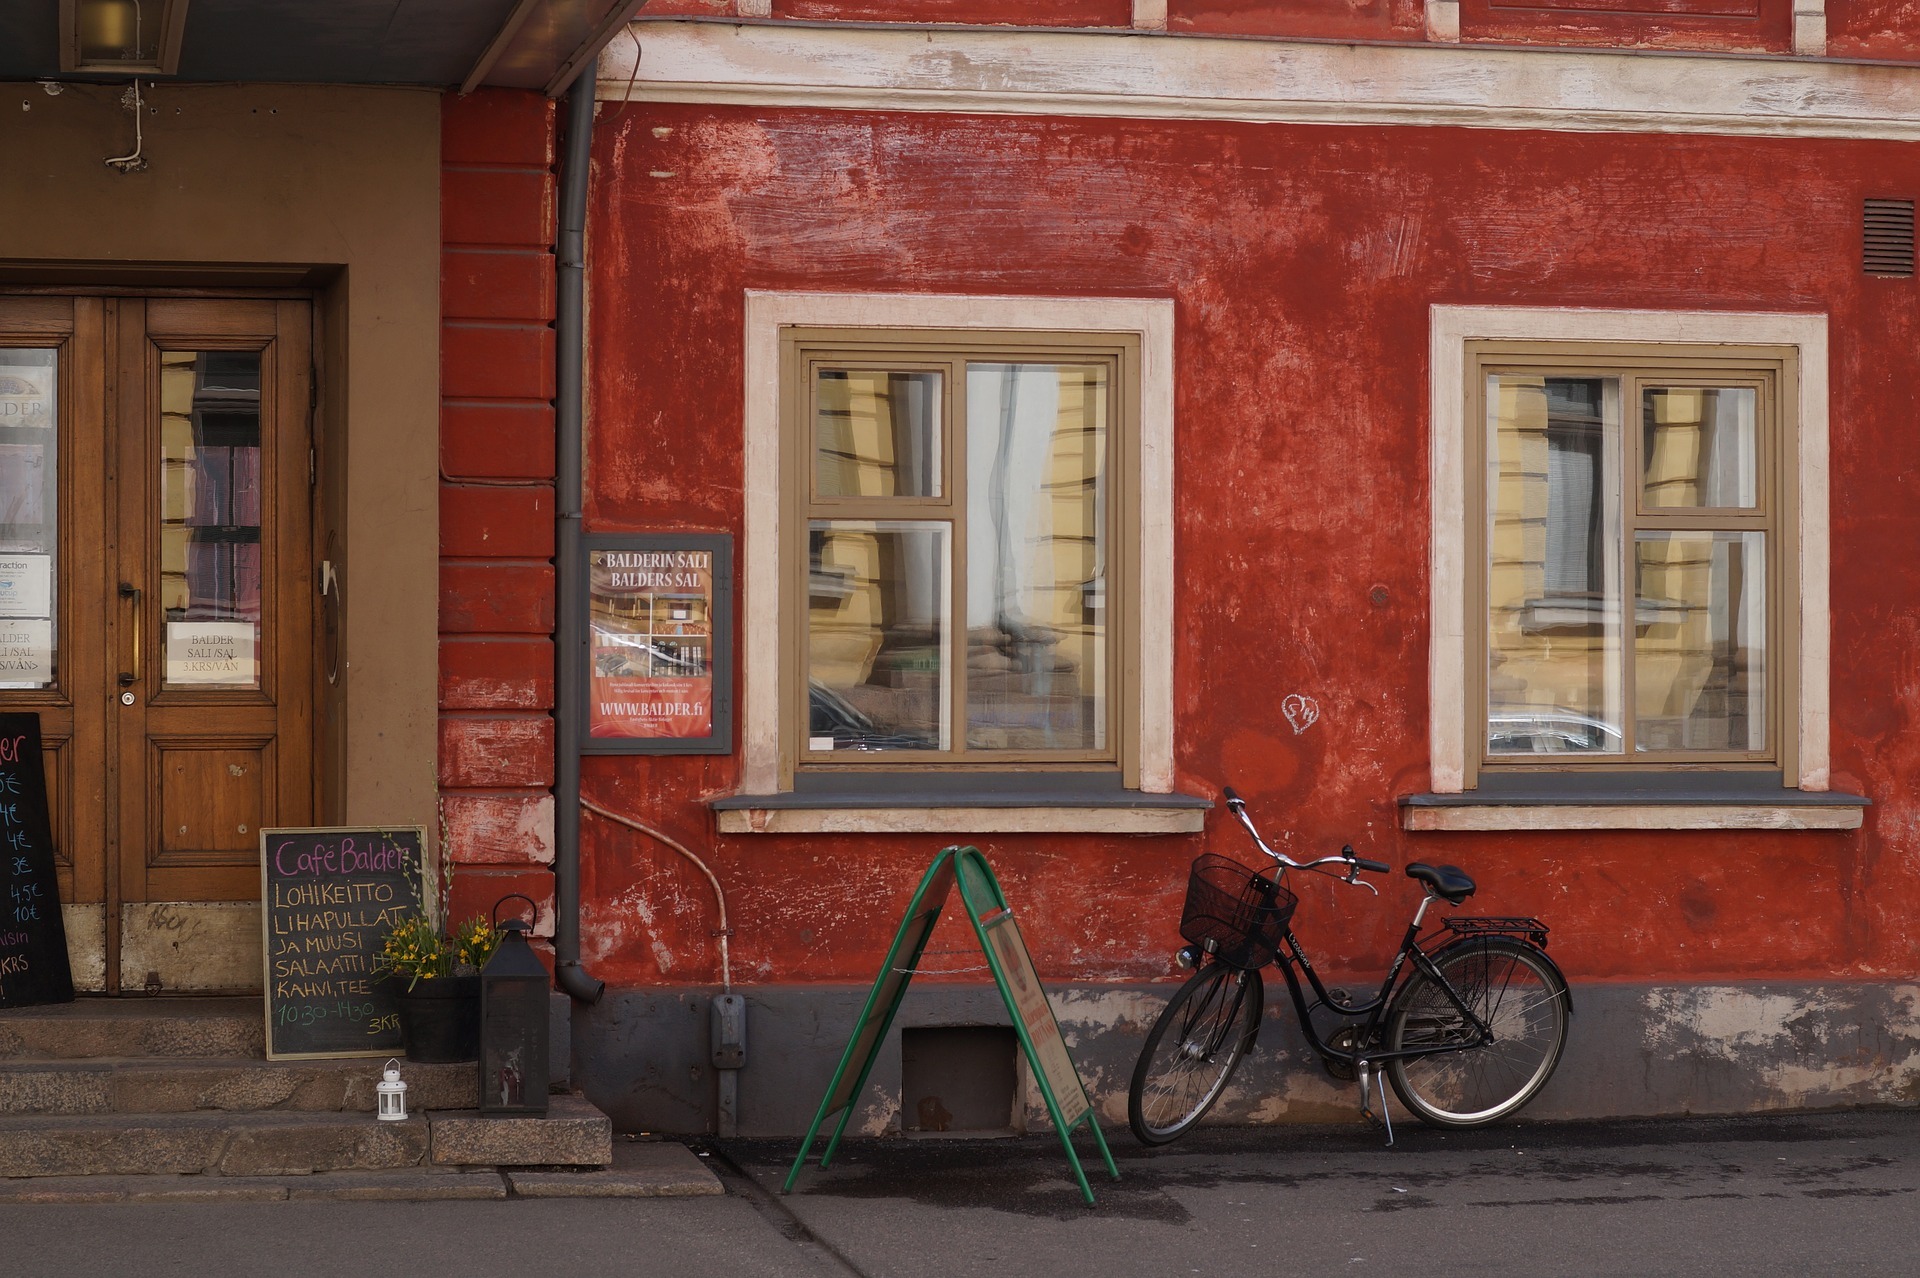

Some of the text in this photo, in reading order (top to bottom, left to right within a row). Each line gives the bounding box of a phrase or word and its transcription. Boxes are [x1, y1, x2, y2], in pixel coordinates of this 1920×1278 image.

[0, 402, 44, 416] DER
[606, 553, 708, 569] BALDERIN SALI
[611, 572, 701, 588] BALDERS SAL
[0, 633, 31, 643] LDER
[191, 635, 235, 645] BALDER
[187, 648, 211, 658] SALI
[600, 701, 703, 716] WWW.BALDER.fi
[0, 735, 26, 765] er
[7, 830, 32, 851] 4€
[275, 838, 410, 876] Café Balder
[11, 856, 33, 877] 3€
[13, 904, 40, 922] 10€
[274, 905, 408, 935] LIHAPULLAT
[275, 931, 363, 956] JA MUUSI
[0, 954, 29, 980] KRS
